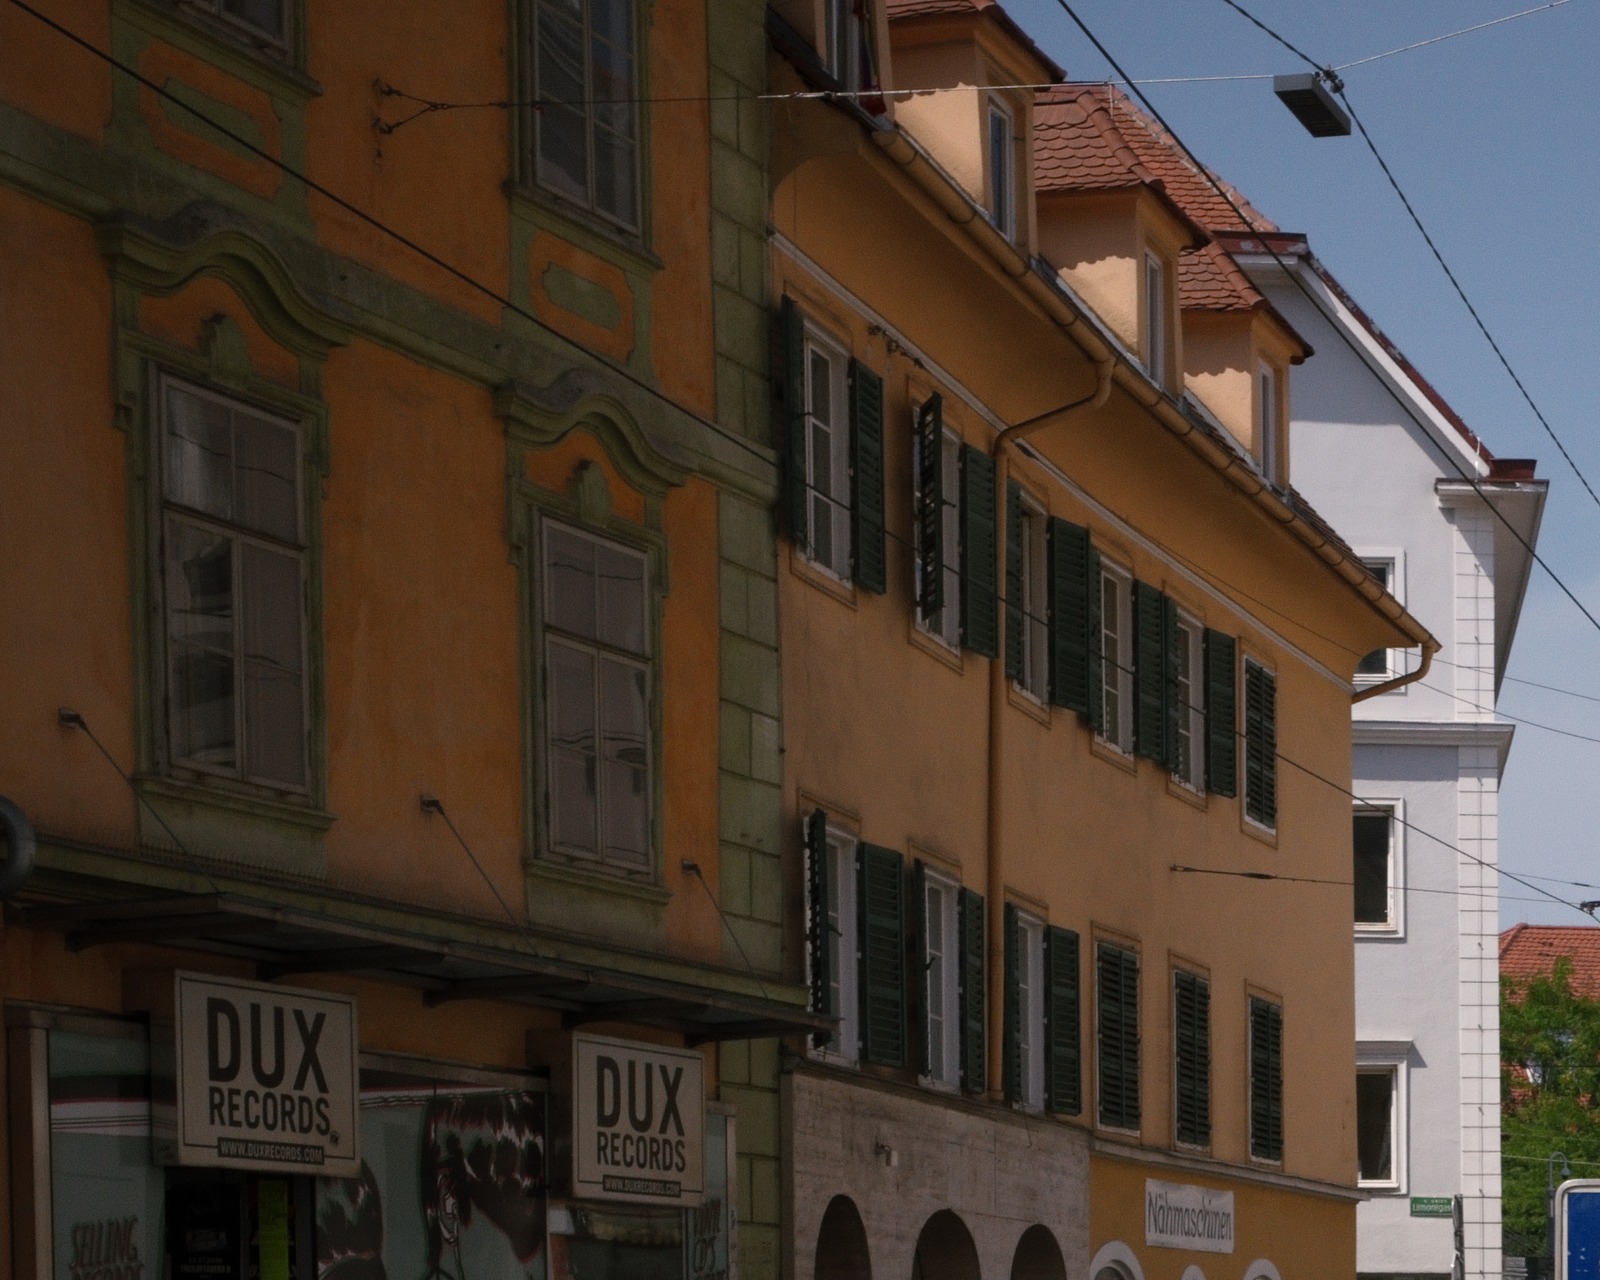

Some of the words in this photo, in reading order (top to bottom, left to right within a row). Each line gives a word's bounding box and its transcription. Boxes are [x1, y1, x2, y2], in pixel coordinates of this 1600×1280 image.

[207, 997, 329, 1094] DUX
[209, 1086, 331, 1136] RECORDS
[596, 1055, 685, 1136] DUX
[220, 1141, 323, 1163] WWW.DUXRECORDS.COM
[597, 1131, 686, 1173] RECORDS
[604, 1176, 681, 1197] WWW.DUXRECORDS.COM
[1148, 1191, 1232, 1240] Nähmaschinen
[68, 1215, 139, 1271] SELLING
